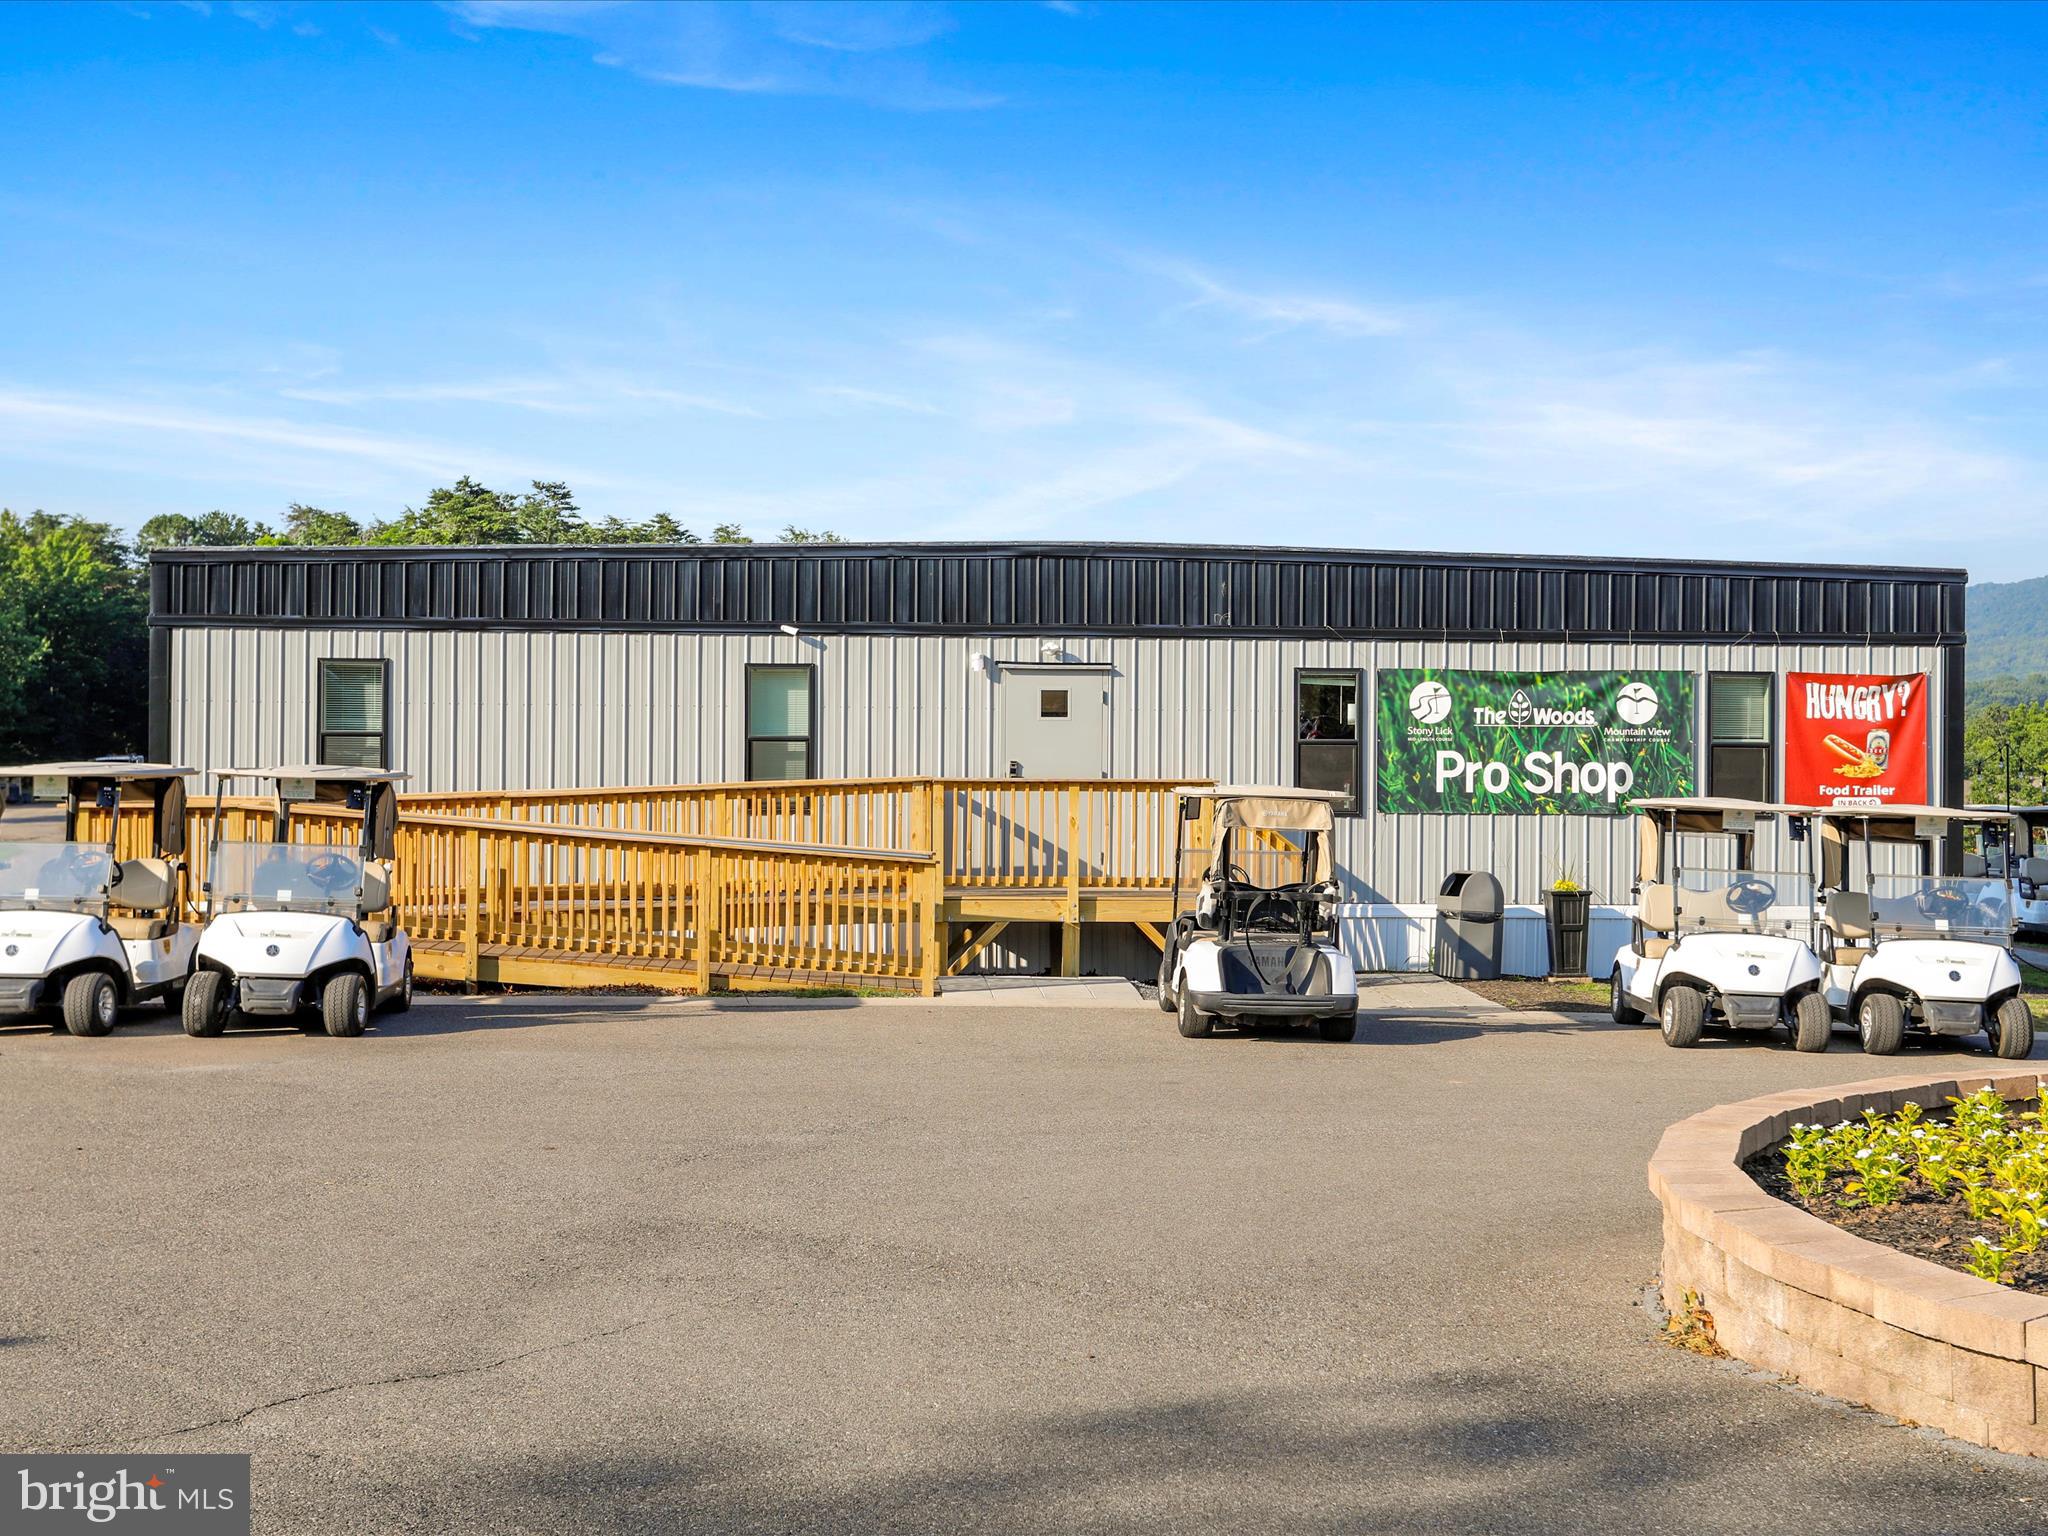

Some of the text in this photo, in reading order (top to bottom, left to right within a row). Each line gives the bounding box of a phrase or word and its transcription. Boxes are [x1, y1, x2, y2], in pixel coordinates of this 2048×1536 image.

[1805, 681, 1911, 722] HUNGRY?
[1473, 706, 1595, 725] The Woods
[1407, 726, 1453, 737] Stony Lick
[1604, 727, 1671, 736] Mountain View
[1435, 750, 1634, 803] Pro Shop
[1819, 785, 1896, 796] Food Trailer
[1248, 956, 1286, 968] YAMAH
